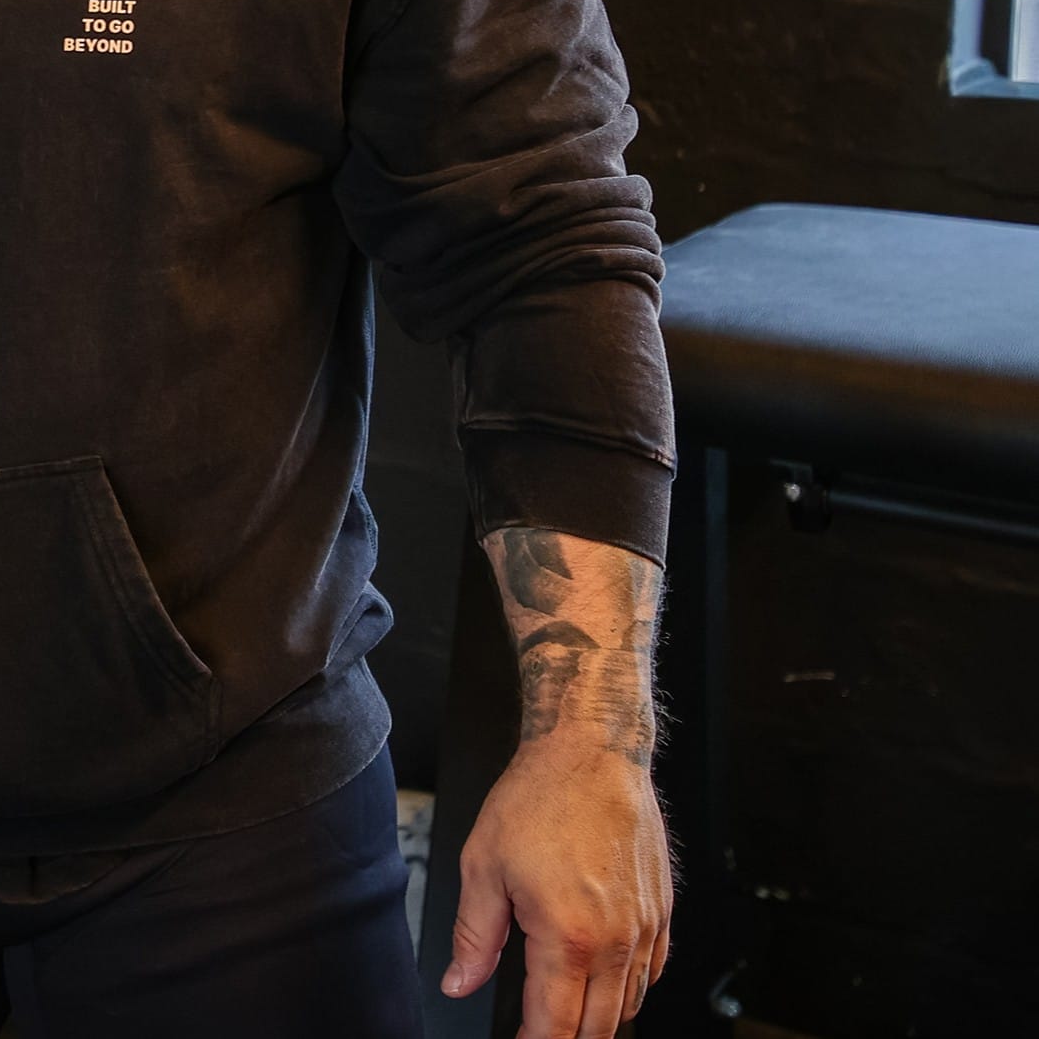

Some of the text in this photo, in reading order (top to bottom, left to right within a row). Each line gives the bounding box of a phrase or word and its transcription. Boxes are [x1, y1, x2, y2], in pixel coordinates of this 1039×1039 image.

[82, 18, 135, 34] TO GO
[63, 37, 133, 54] BEYOND
